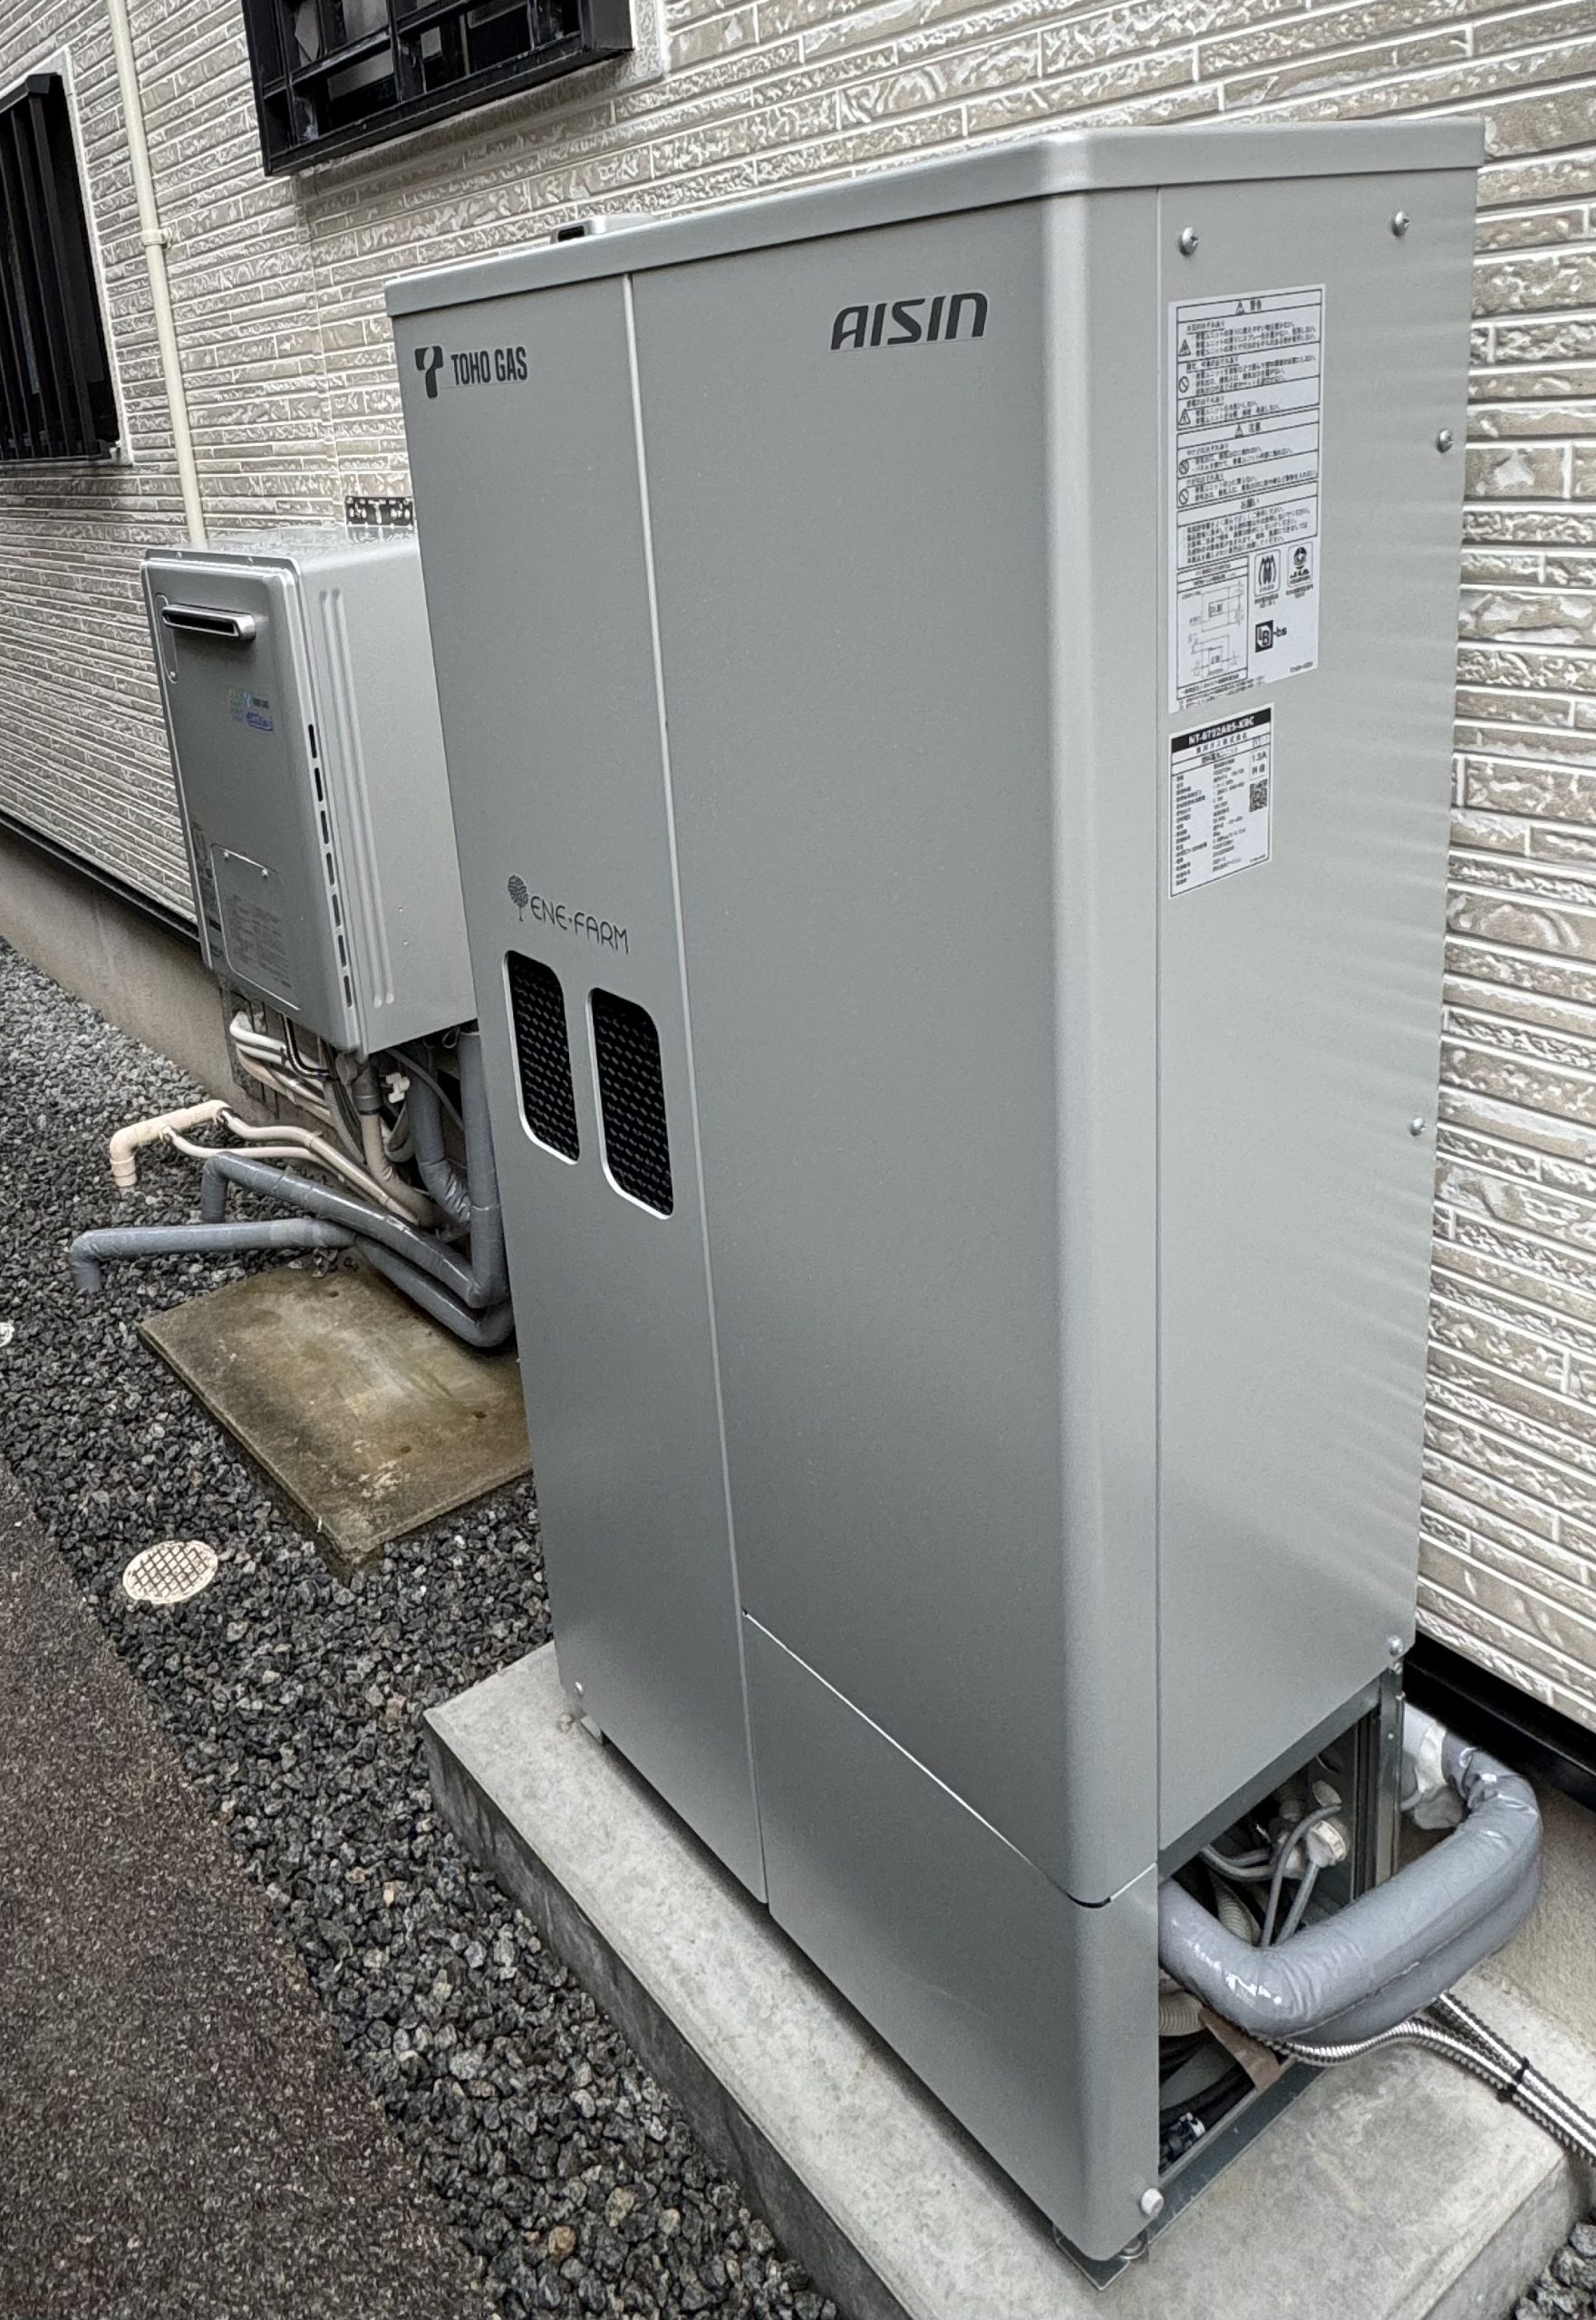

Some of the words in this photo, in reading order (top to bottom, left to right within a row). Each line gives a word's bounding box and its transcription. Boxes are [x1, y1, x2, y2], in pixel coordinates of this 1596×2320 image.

[830, 293, 988, 350] AISIN
[450, 351, 491, 385] TOHO
[494, 346, 527, 382] GAS
